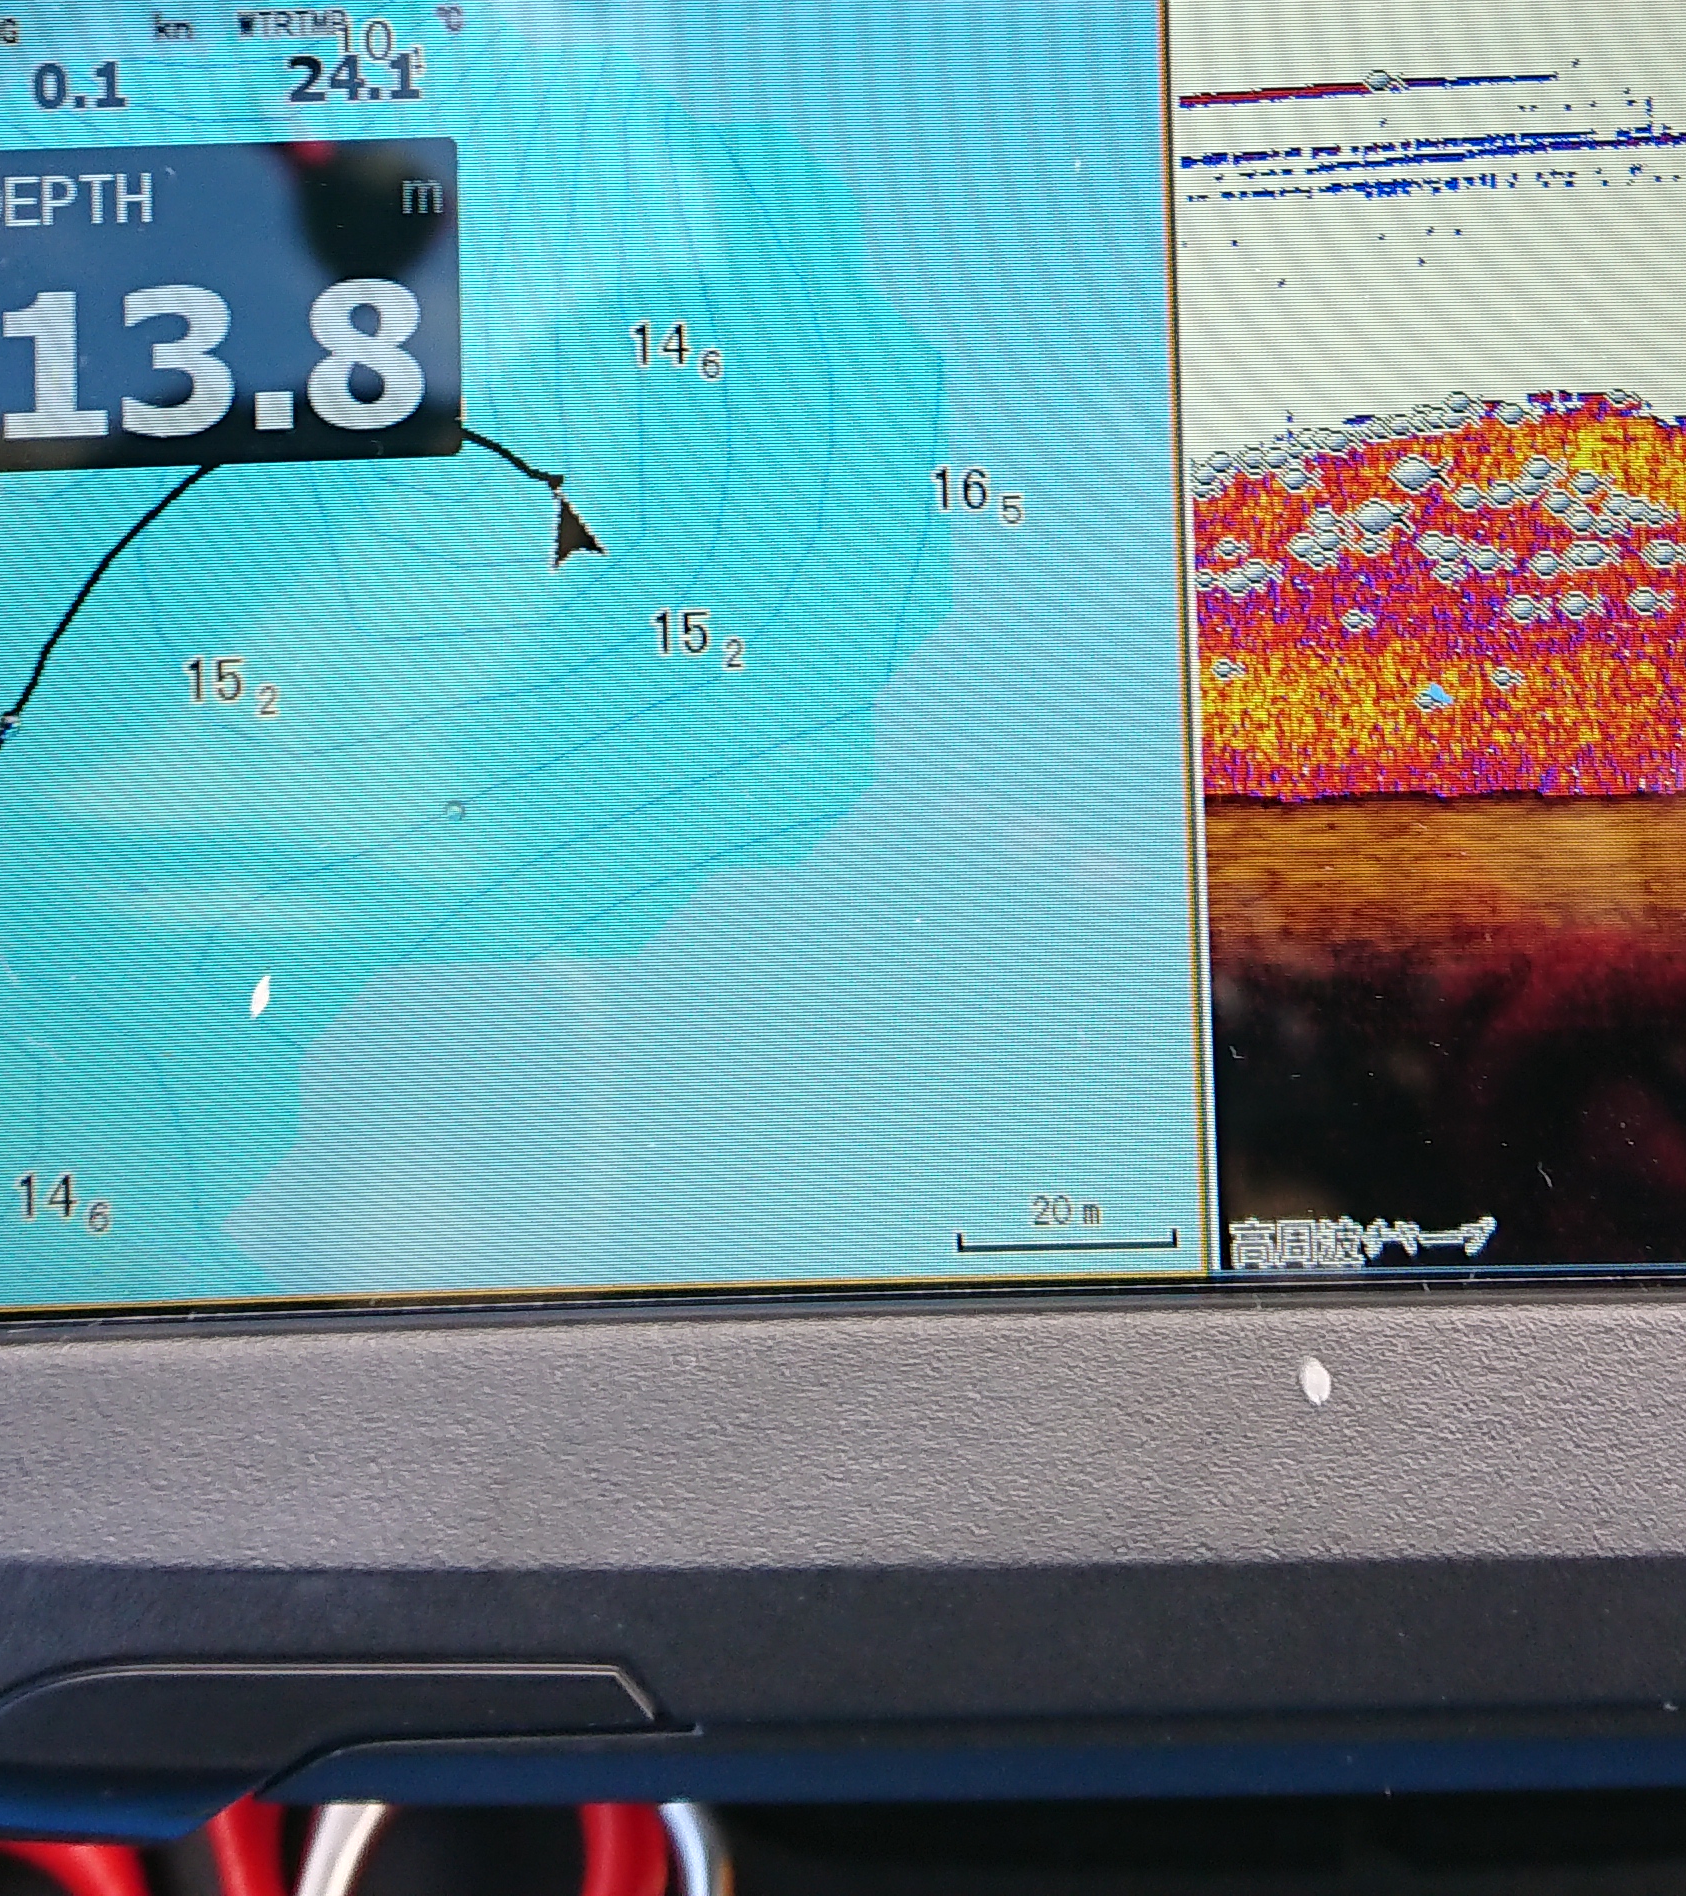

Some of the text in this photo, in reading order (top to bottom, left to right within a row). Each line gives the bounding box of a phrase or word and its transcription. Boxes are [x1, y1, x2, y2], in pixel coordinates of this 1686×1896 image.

[153, 12, 193, 41] kn
[32, 61, 128, 110] 0.1
[288, 54, 422, 103] 24.1
[400, 178, 444, 214] m
[1, 277, 426, 440] 13.8
